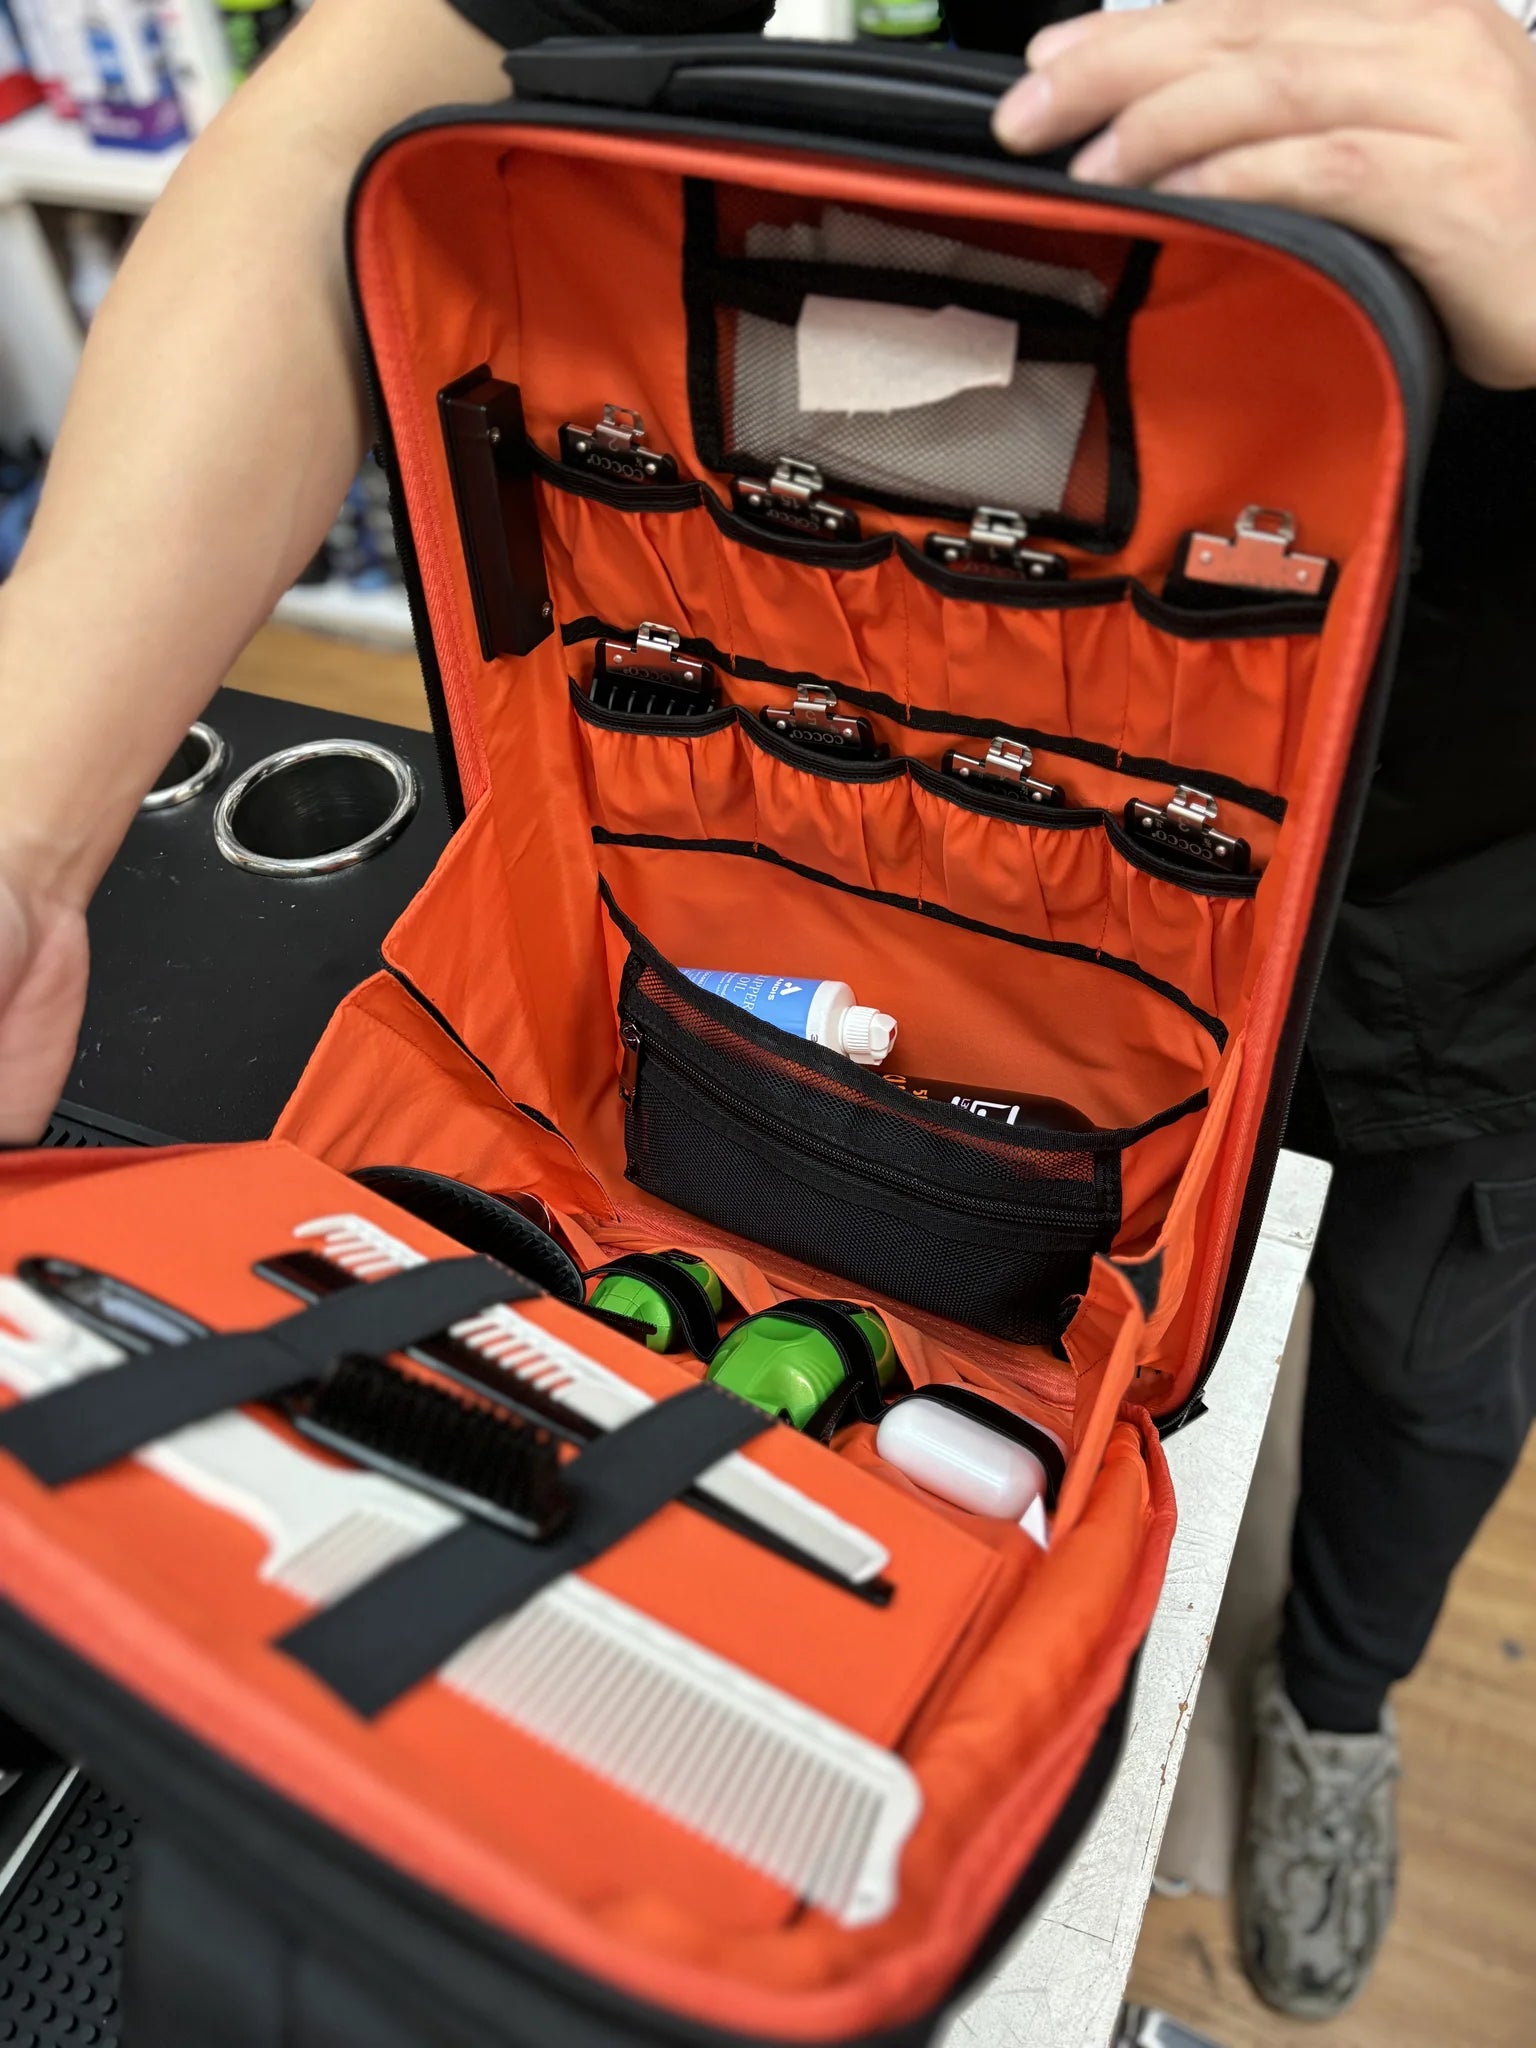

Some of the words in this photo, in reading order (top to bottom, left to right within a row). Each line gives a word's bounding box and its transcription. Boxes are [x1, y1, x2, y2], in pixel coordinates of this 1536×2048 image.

[608, 437, 619, 452] 2
[589, 453, 645, 481] COCCO
[805, 710, 817, 726] 5
[792, 729, 844, 745] COCCO
[1178, 816, 1191, 833] 3
[1156, 830, 1213, 860] COCCO
[732, 976, 752, 993] OIL
[742, 974, 769, 1011] LIPPER
[767, 977, 784, 1001] ANDIS
